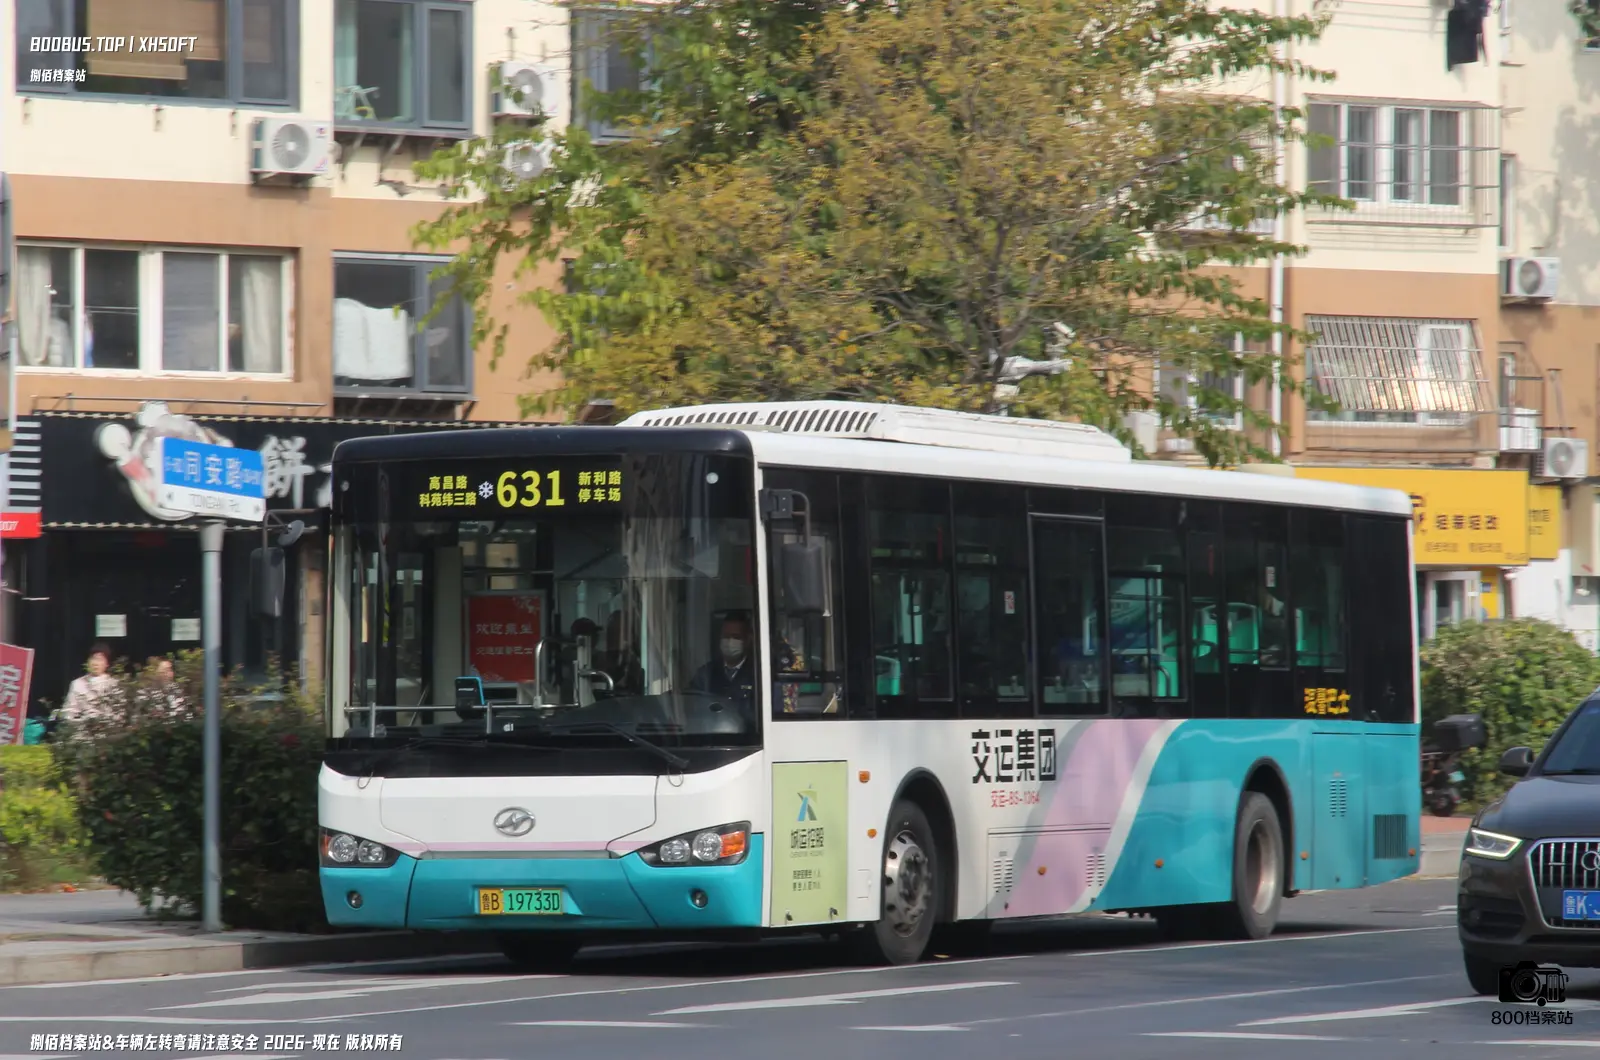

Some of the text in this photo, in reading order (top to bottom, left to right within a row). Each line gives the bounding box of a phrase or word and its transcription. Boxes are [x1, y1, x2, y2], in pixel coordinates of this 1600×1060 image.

[429, 475, 468, 490] 高昌路
[578, 471, 622, 486] 新利路
[496, 469, 565, 508] 631
[578, 487, 621, 502] 停车场
[419, 492, 477, 507] 科苑纬三路
[971, 728, 1056, 784] 交运集团
[508, 892, 560, 911] 19733D
